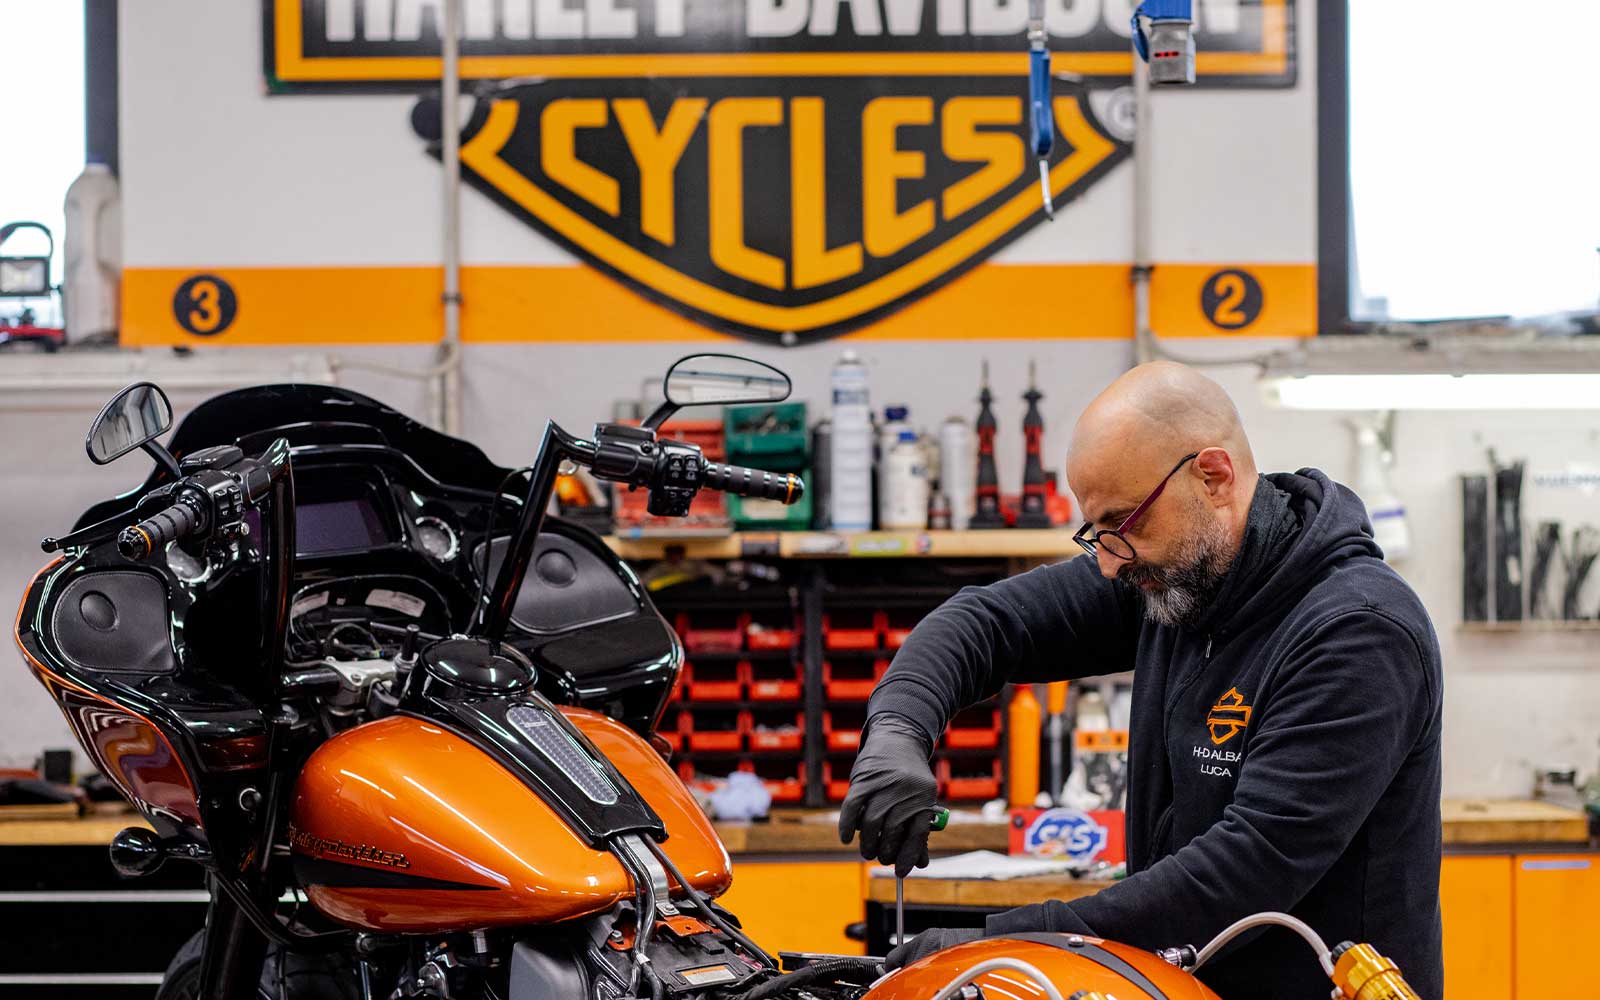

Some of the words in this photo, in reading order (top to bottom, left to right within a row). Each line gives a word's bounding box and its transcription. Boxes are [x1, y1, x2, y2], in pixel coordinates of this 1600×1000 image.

[539, 96, 1026, 291] CYCLES
[190, 281, 221, 331] 3
[1214, 273, 1246, 324] 2
[1200, 763, 1232, 777] LUCA
